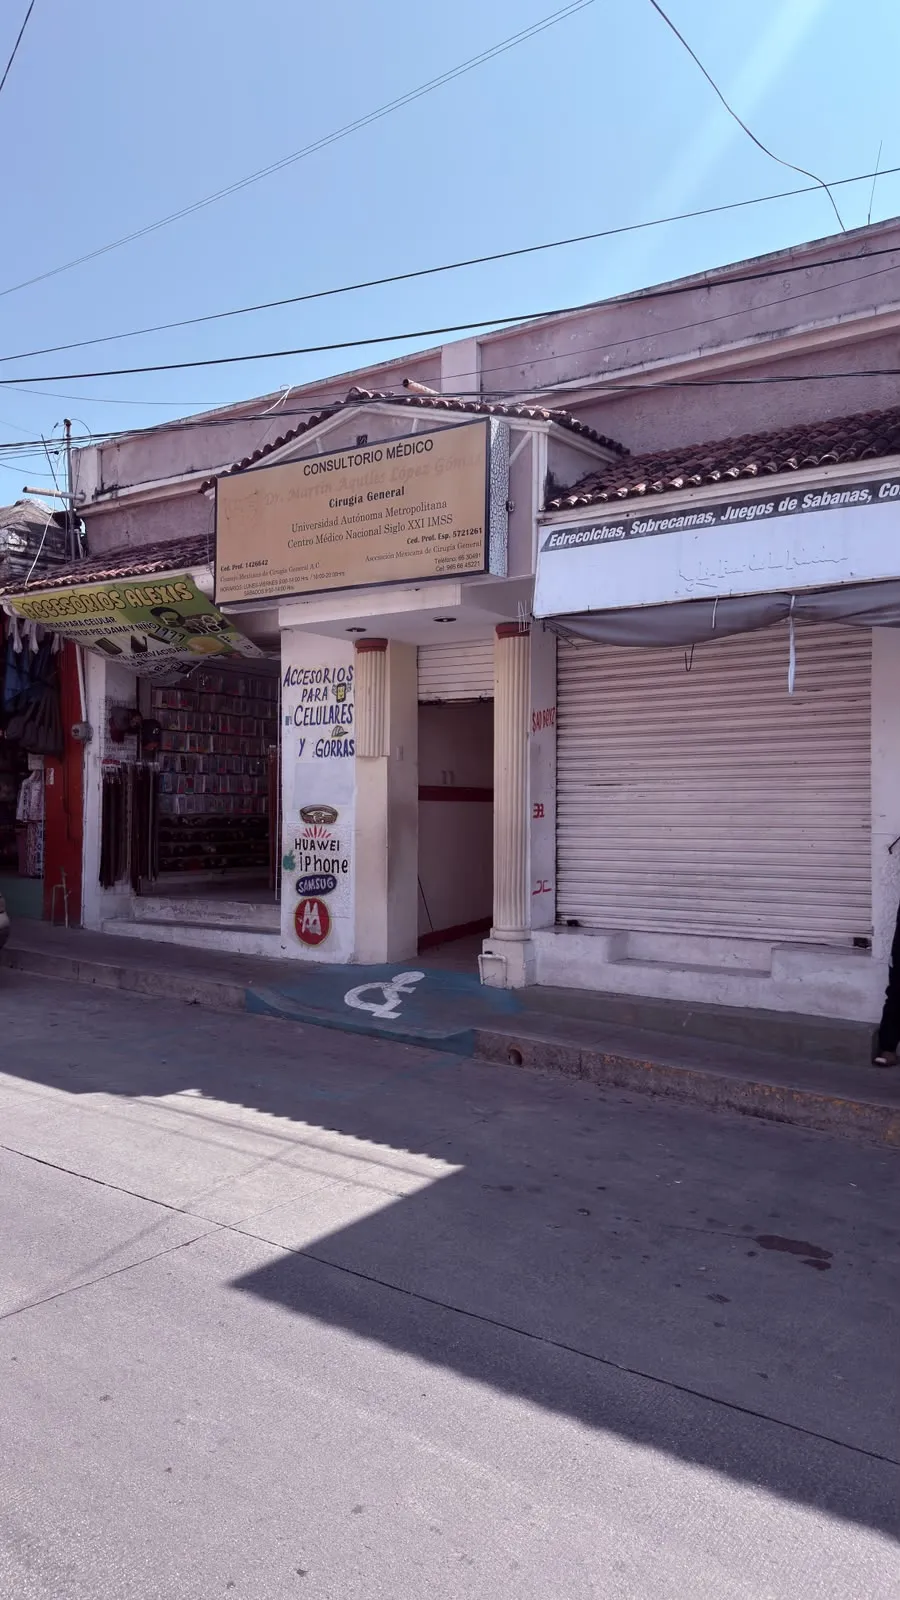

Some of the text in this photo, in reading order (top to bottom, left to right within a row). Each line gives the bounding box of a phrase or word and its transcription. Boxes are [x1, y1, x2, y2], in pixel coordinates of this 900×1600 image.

[303, 439, 434, 477] CONSULTORIO MÉDICO
[329, 486, 405, 509] Cirugía General
[291, 500, 448, 533] Universidad Autónoma Metropolitana
[549, 525, 626, 547] Edrecolchas,
[630, 511, 716, 535] Sobrecamas,
[720, 502, 774, 520] Juegos
[778, 497, 798, 512] de
[801, 488, 873, 509] Sabanas,
[287, 514, 453, 549] Centro Médico Nacional Siglo XXI IMSS
[438, 532, 450, 541] Esp.
[453, 527, 482, 538] 5721261
[457, 540, 482, 549] General
[21, 582, 194, 619] ACCESORIOS ALEXIS
[65, 619, 84, 628] PARA
[84, 616, 117, 626] CELULAR
[107, 625, 129, 635] DAMA
[283, 665, 354, 687] ACCESORIOS
[301, 686, 328, 703] PARA
[294, 703, 354, 727] CELULARES
[298, 738, 355, 758] Y GORRAS
[294, 838, 340, 851] HUAWEI
[299, 852, 348, 874] iPhone
[297, 877, 334, 893] SAMSUG
